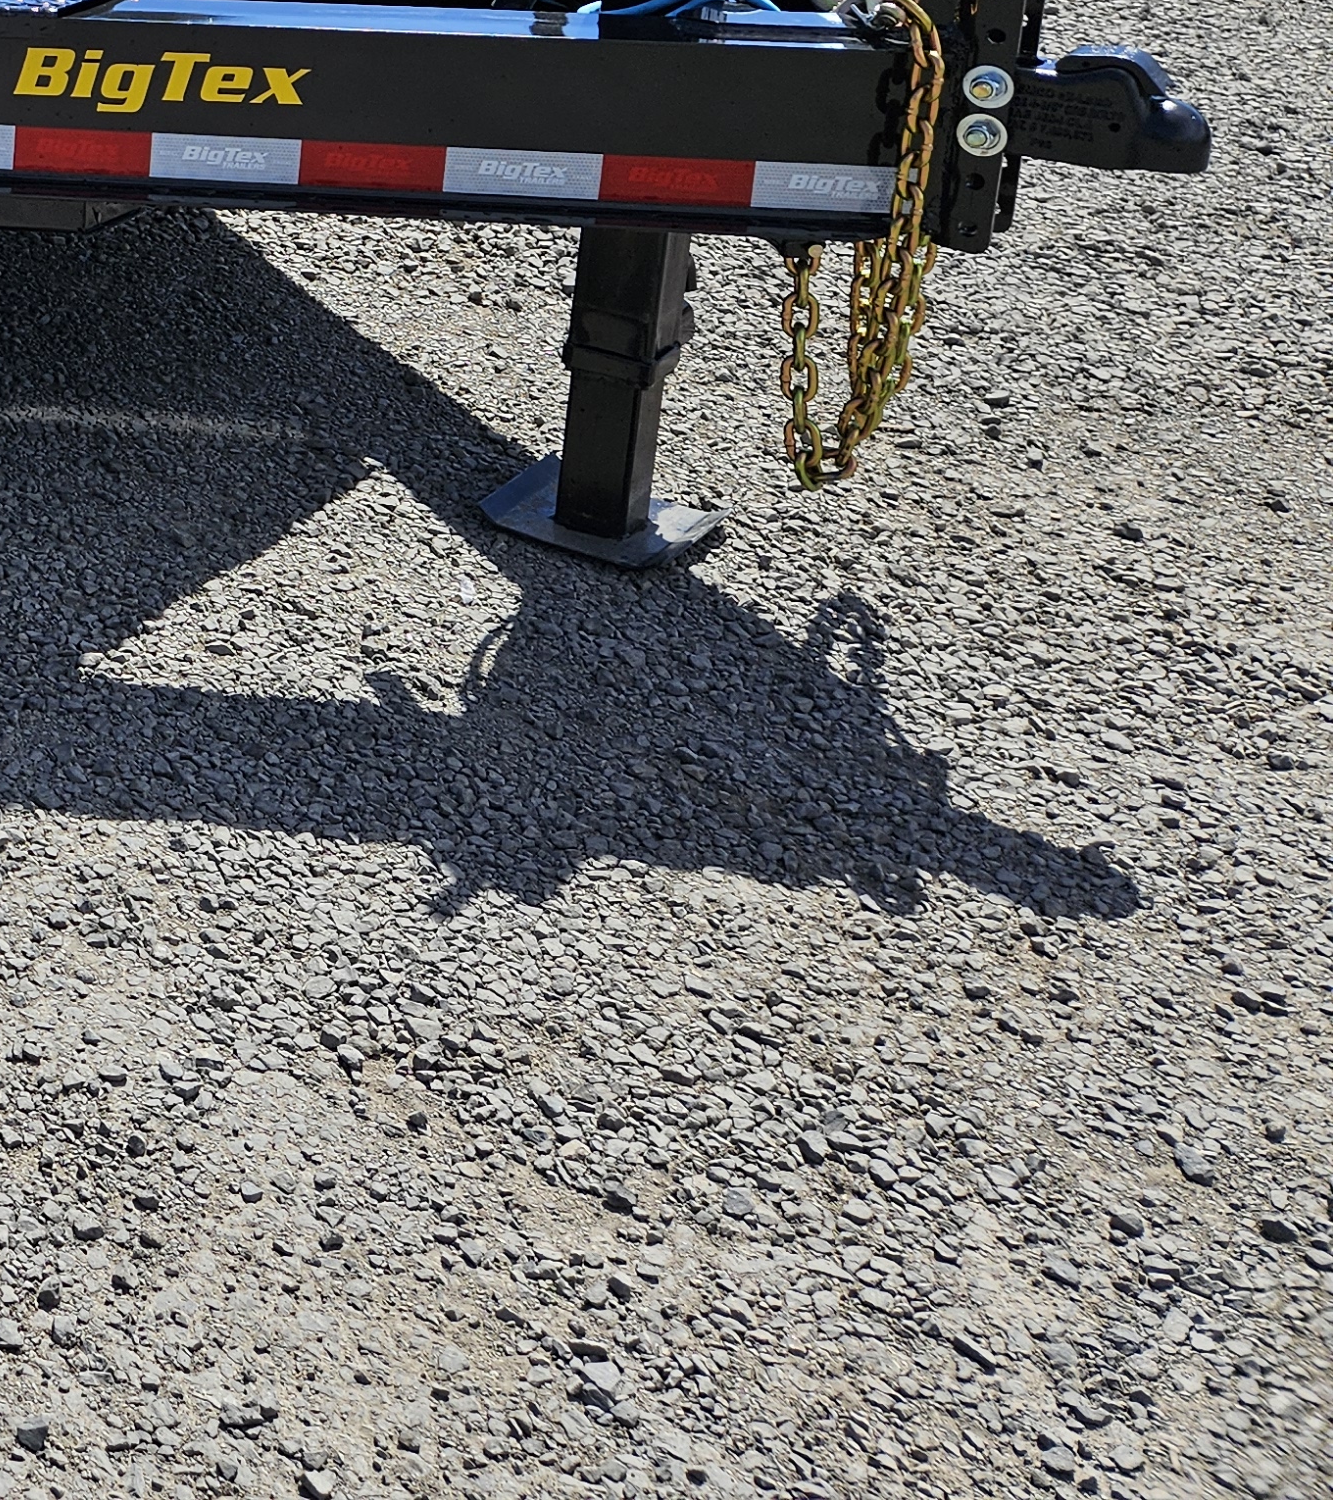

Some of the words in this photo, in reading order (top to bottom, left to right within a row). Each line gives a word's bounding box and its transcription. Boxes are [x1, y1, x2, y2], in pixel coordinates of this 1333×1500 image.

[13, 47, 312, 113] BigTex
[182, 144, 270, 166] BigTex
[221, 160, 267, 171] TRAILERS
[477, 159, 568, 181] BigTex
[519, 176, 565, 187] TRAILERS
[788, 173, 882, 195] BigTex
